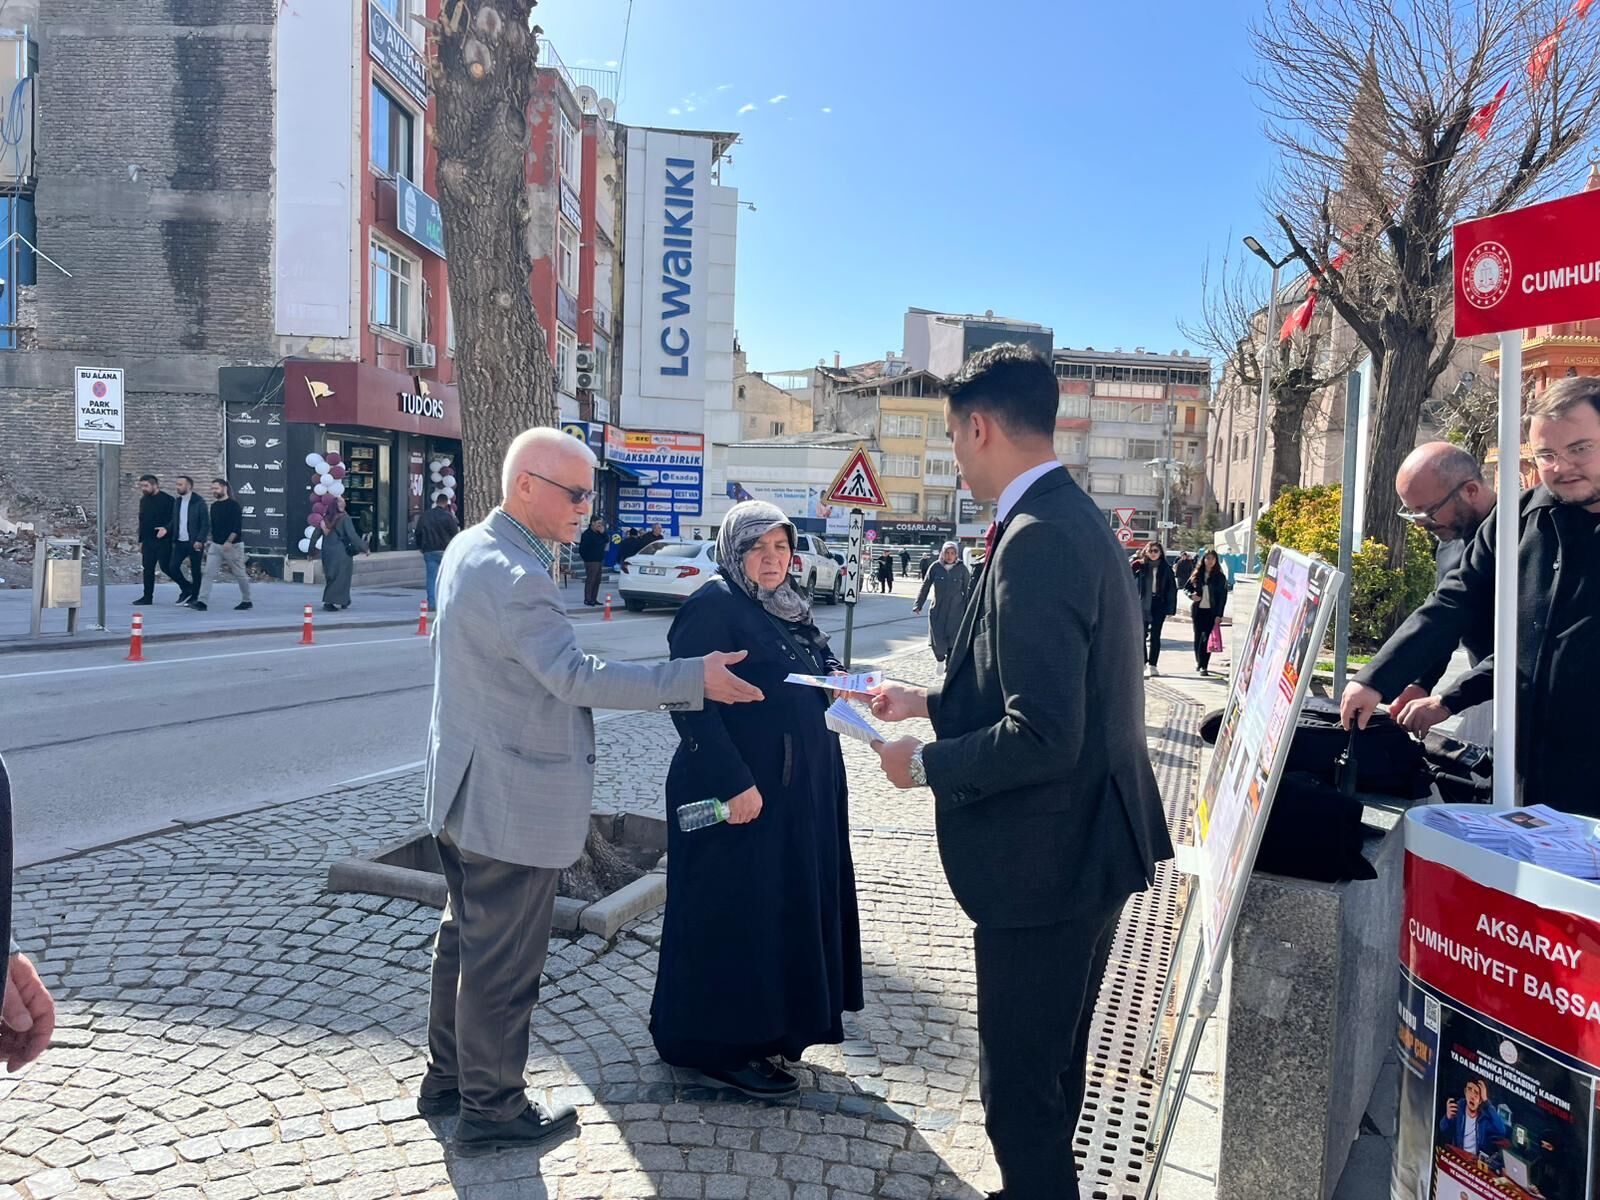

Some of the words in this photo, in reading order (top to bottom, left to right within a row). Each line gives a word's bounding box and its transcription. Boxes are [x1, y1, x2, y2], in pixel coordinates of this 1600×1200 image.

[660, 326, 690, 377] LC
[92, 372, 117, 380] ALANA
[81, 407, 119, 416] YASAKTIR
[89, 400, 110, 408] PARK
[401, 392, 445, 419] TUDORS
[625, 453, 668, 463] AKSARAY
[846, 536, 859, 599] YAYA
[1476, 913, 1582, 970] AKSARAY
[1409, 917, 1518, 987] CUMHURİYET
[1523, 972, 1600, 1025] BAŞSA
[1450, 1050, 1459, 1061] YA
[1459, 1055, 1469, 1068] DA
[1478, 1057, 1503, 1075] BANKA
